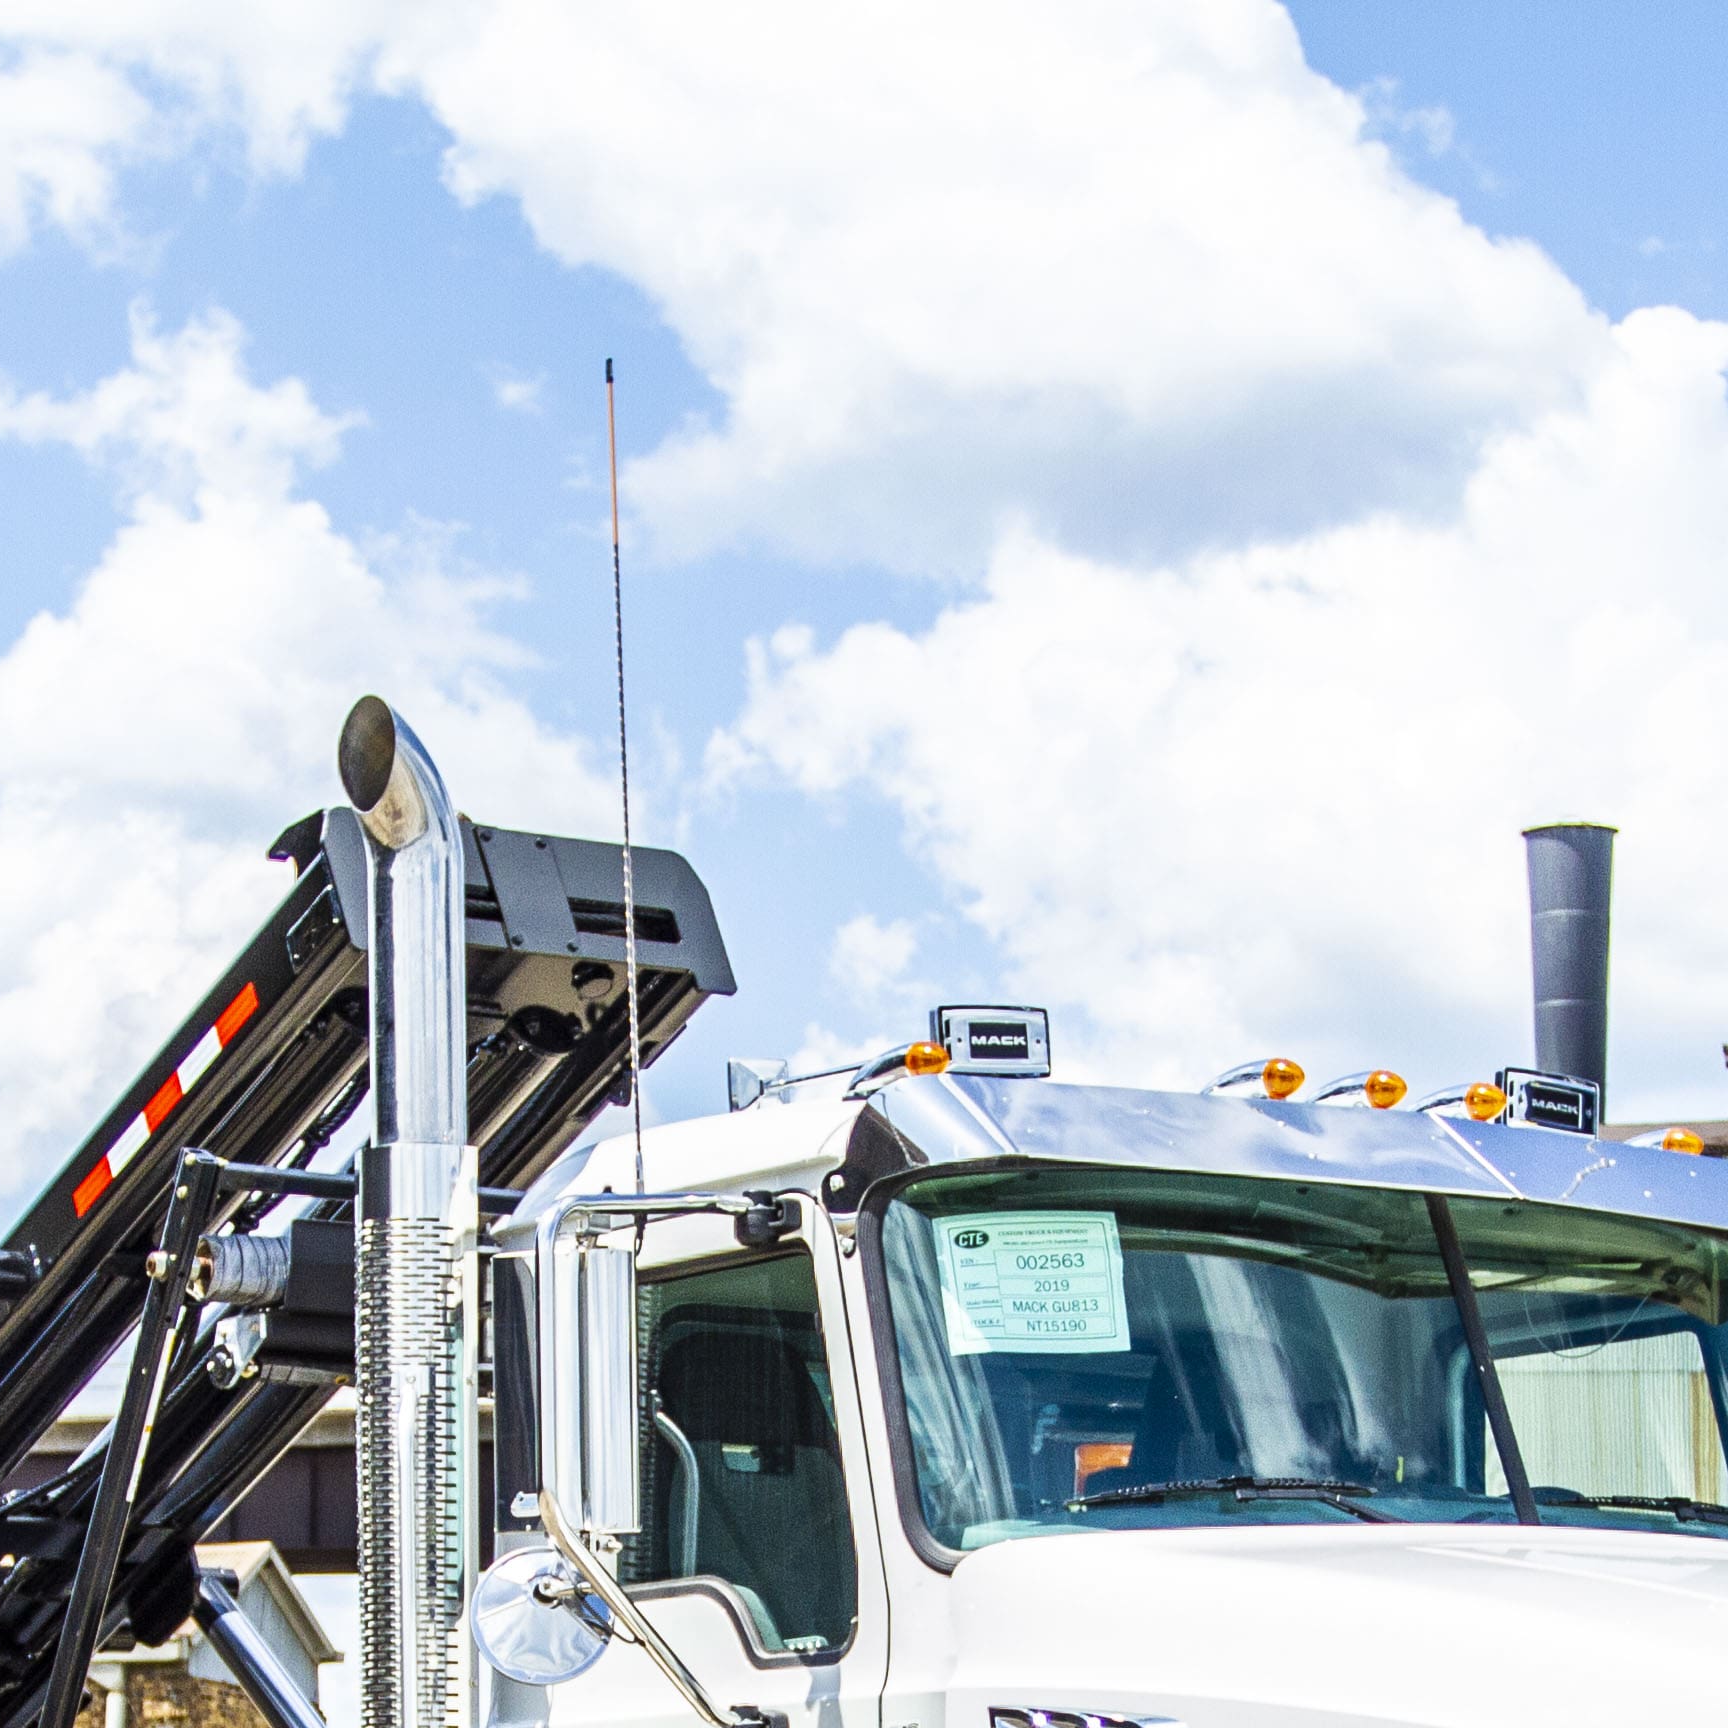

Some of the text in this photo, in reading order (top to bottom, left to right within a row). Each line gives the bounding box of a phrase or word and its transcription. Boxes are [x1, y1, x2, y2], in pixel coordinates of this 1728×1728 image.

[970, 1035, 1027, 1046] MACK
[1531, 1097, 1579, 1116] MACK
[958, 1232, 985, 1247] CTE
[1016, 1252, 1085, 1270] 002563
[1034, 1279, 1070, 1292] 2019
[1012, 1300, 1048, 1314] MACK
[1052, 1299, 1099, 1313] GU813
[1027, 1319, 1087, 1333] NT15190
